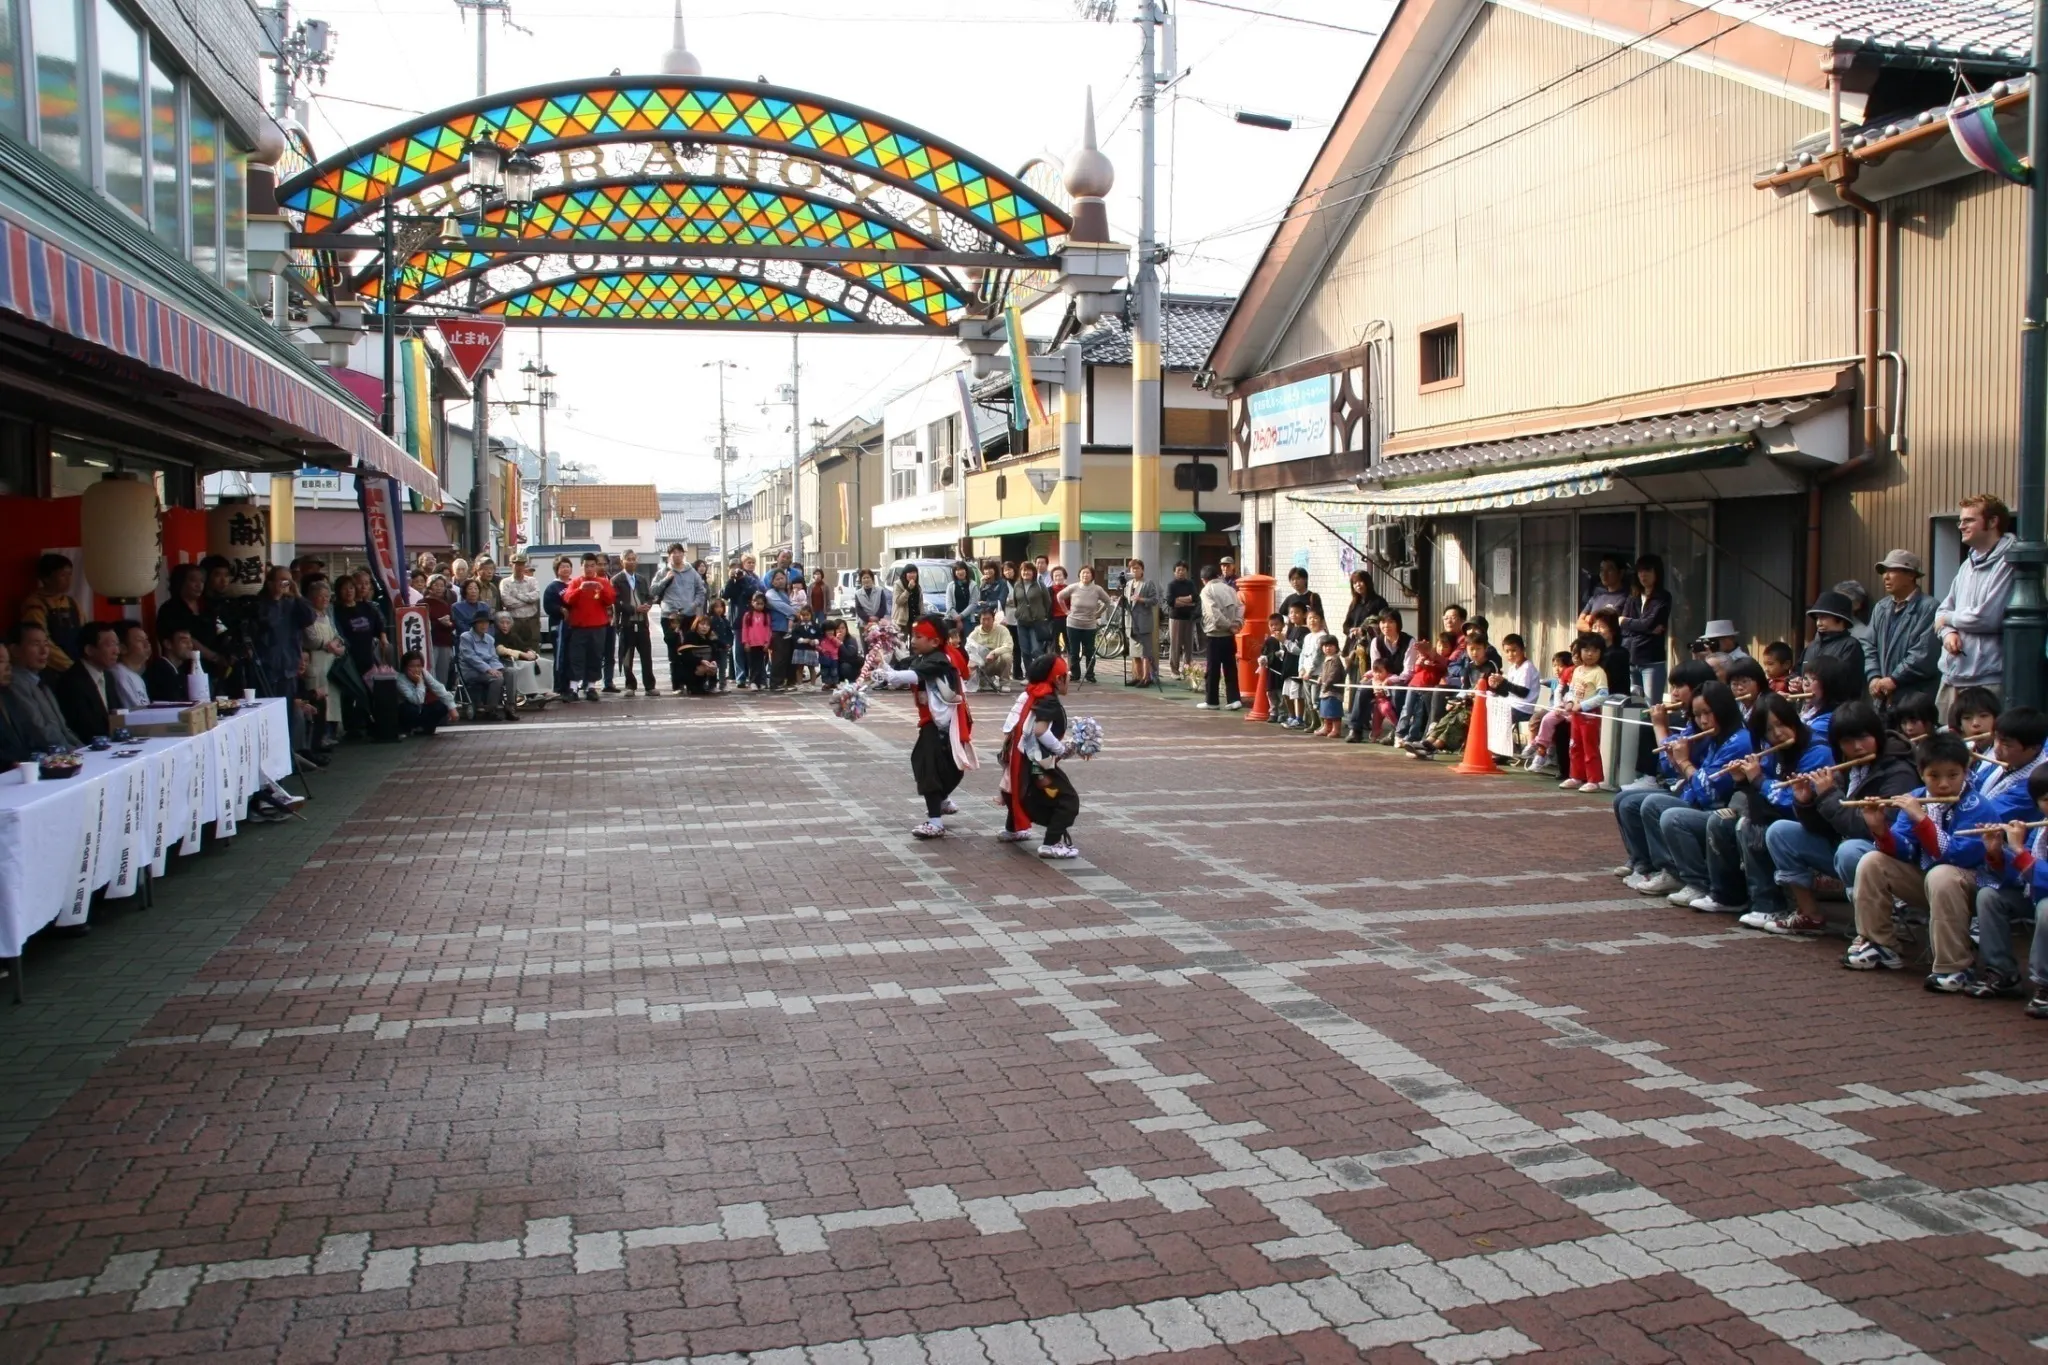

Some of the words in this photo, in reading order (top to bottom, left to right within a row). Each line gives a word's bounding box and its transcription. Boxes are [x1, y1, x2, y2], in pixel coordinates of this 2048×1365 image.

[408, 141, 943, 242] HRANOYA
[449, 330, 491, 346] 止まれ
[1253, 417, 1327, 453] ひらのやエコステーション
[301, 480, 337, 488] 軽車両を除く
[404, 616, 424, 651] たば
